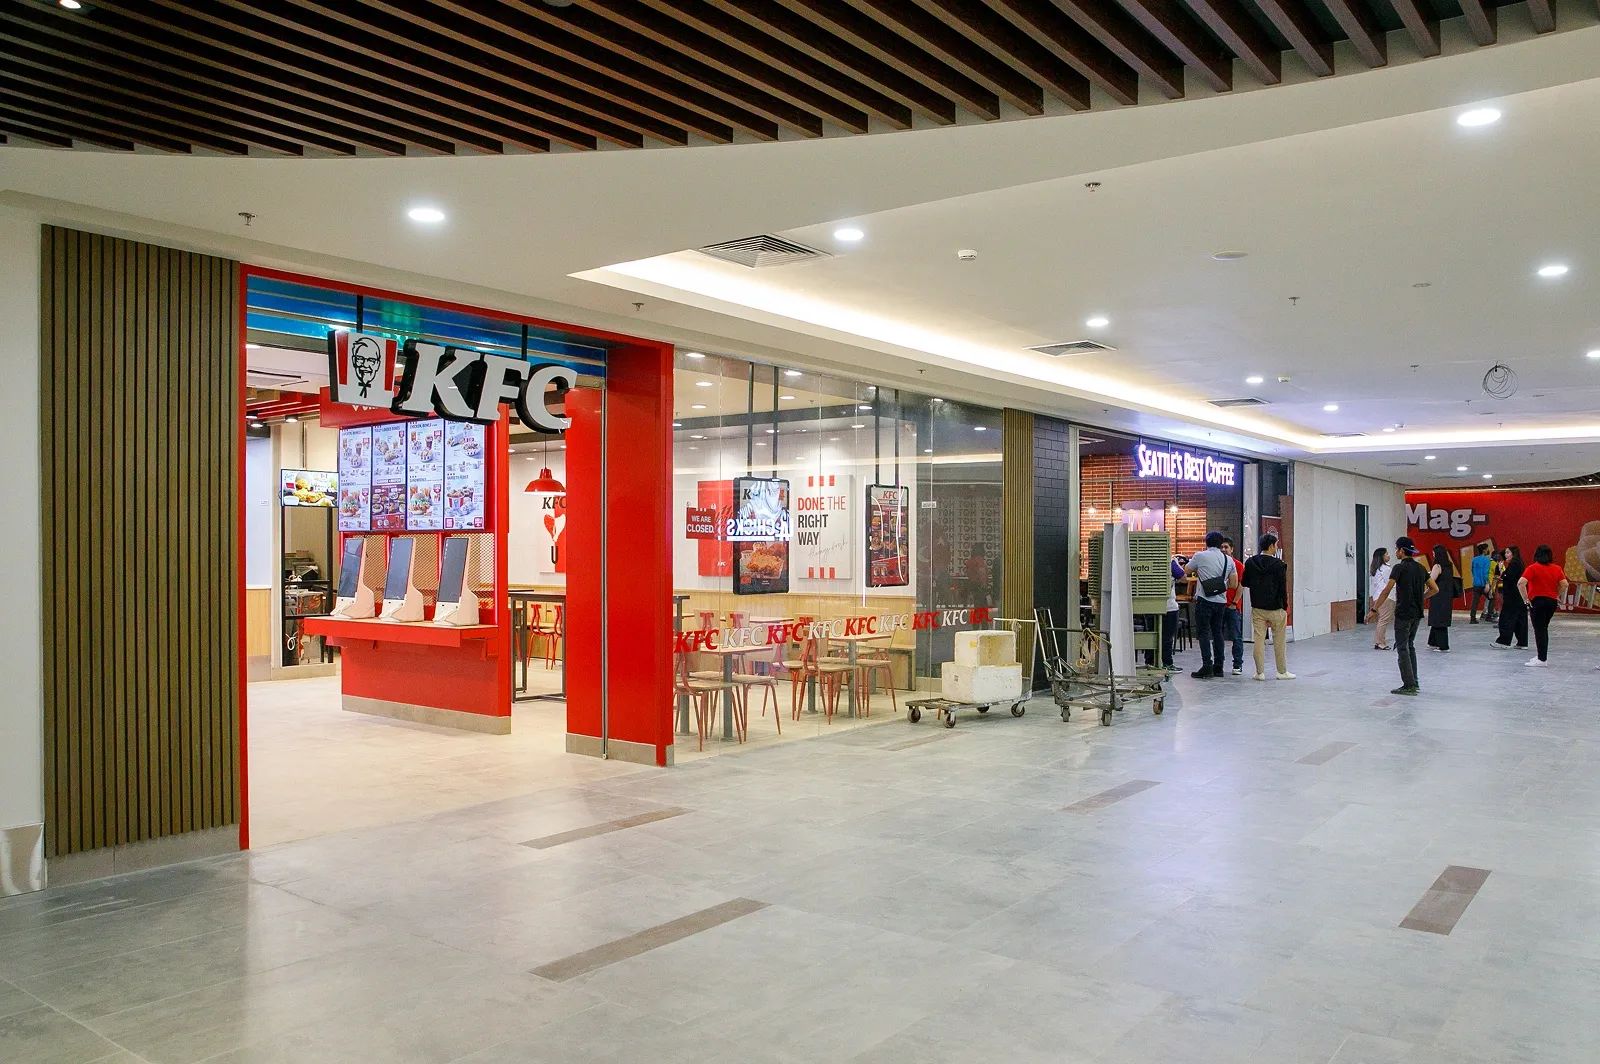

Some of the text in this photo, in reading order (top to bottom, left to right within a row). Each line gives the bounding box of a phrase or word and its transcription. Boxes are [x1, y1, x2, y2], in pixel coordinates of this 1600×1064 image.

[397, 341, 577, 432] KFC
[798, 496, 847, 511] DONE THE
[798, 514, 829, 528] RIGHT
[798, 531, 820, 546] WAY
[551, 546, 559, 565] U
[674, 629, 719, 653] KFC
[723, 626, 763, 648] KFC
[766, 622, 804, 645] KFC
[807, 619, 841, 640] KFC
[844, 616, 877, 636] KFC
[880, 613, 910, 633] KFC
[912, 611, 940, 630] KFC
[942, 609, 968, 627] KFC
